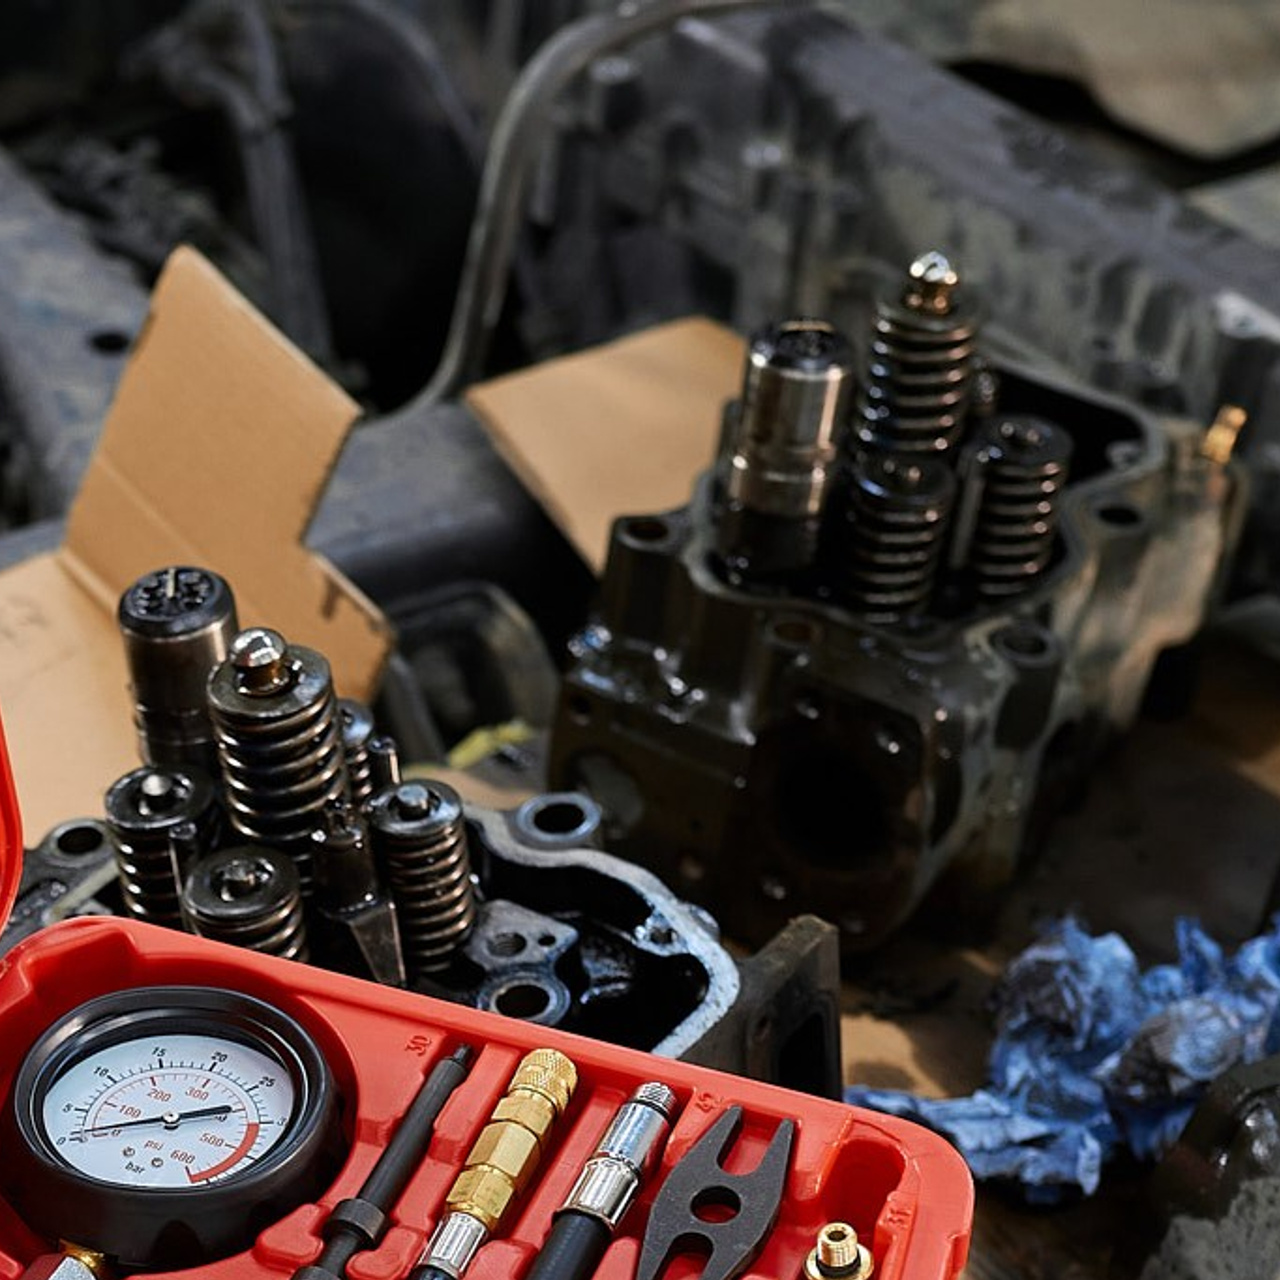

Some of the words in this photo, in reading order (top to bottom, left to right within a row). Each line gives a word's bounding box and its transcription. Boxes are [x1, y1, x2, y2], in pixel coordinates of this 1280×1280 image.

[404, 1034, 432, 1057] 30
[151, 1046, 167, 1058] 15
[211, 1051, 228, 1063] 20
[93, 1065, 109, 1077] 10
[259, 1076, 276, 1087] 25
[147, 1088, 171, 1102] 200
[185, 1086, 209, 1101] 300
[62, 1103, 73, 1113] 5
[119, 1104, 141, 1118] 100
[56, 1136, 66, 1146] 0
[143, 1140, 164, 1151] psi
[200, 1133, 224, 1148] 500
[170, 1149, 196, 1165] 600
[125, 1161, 145, 1174] bar
